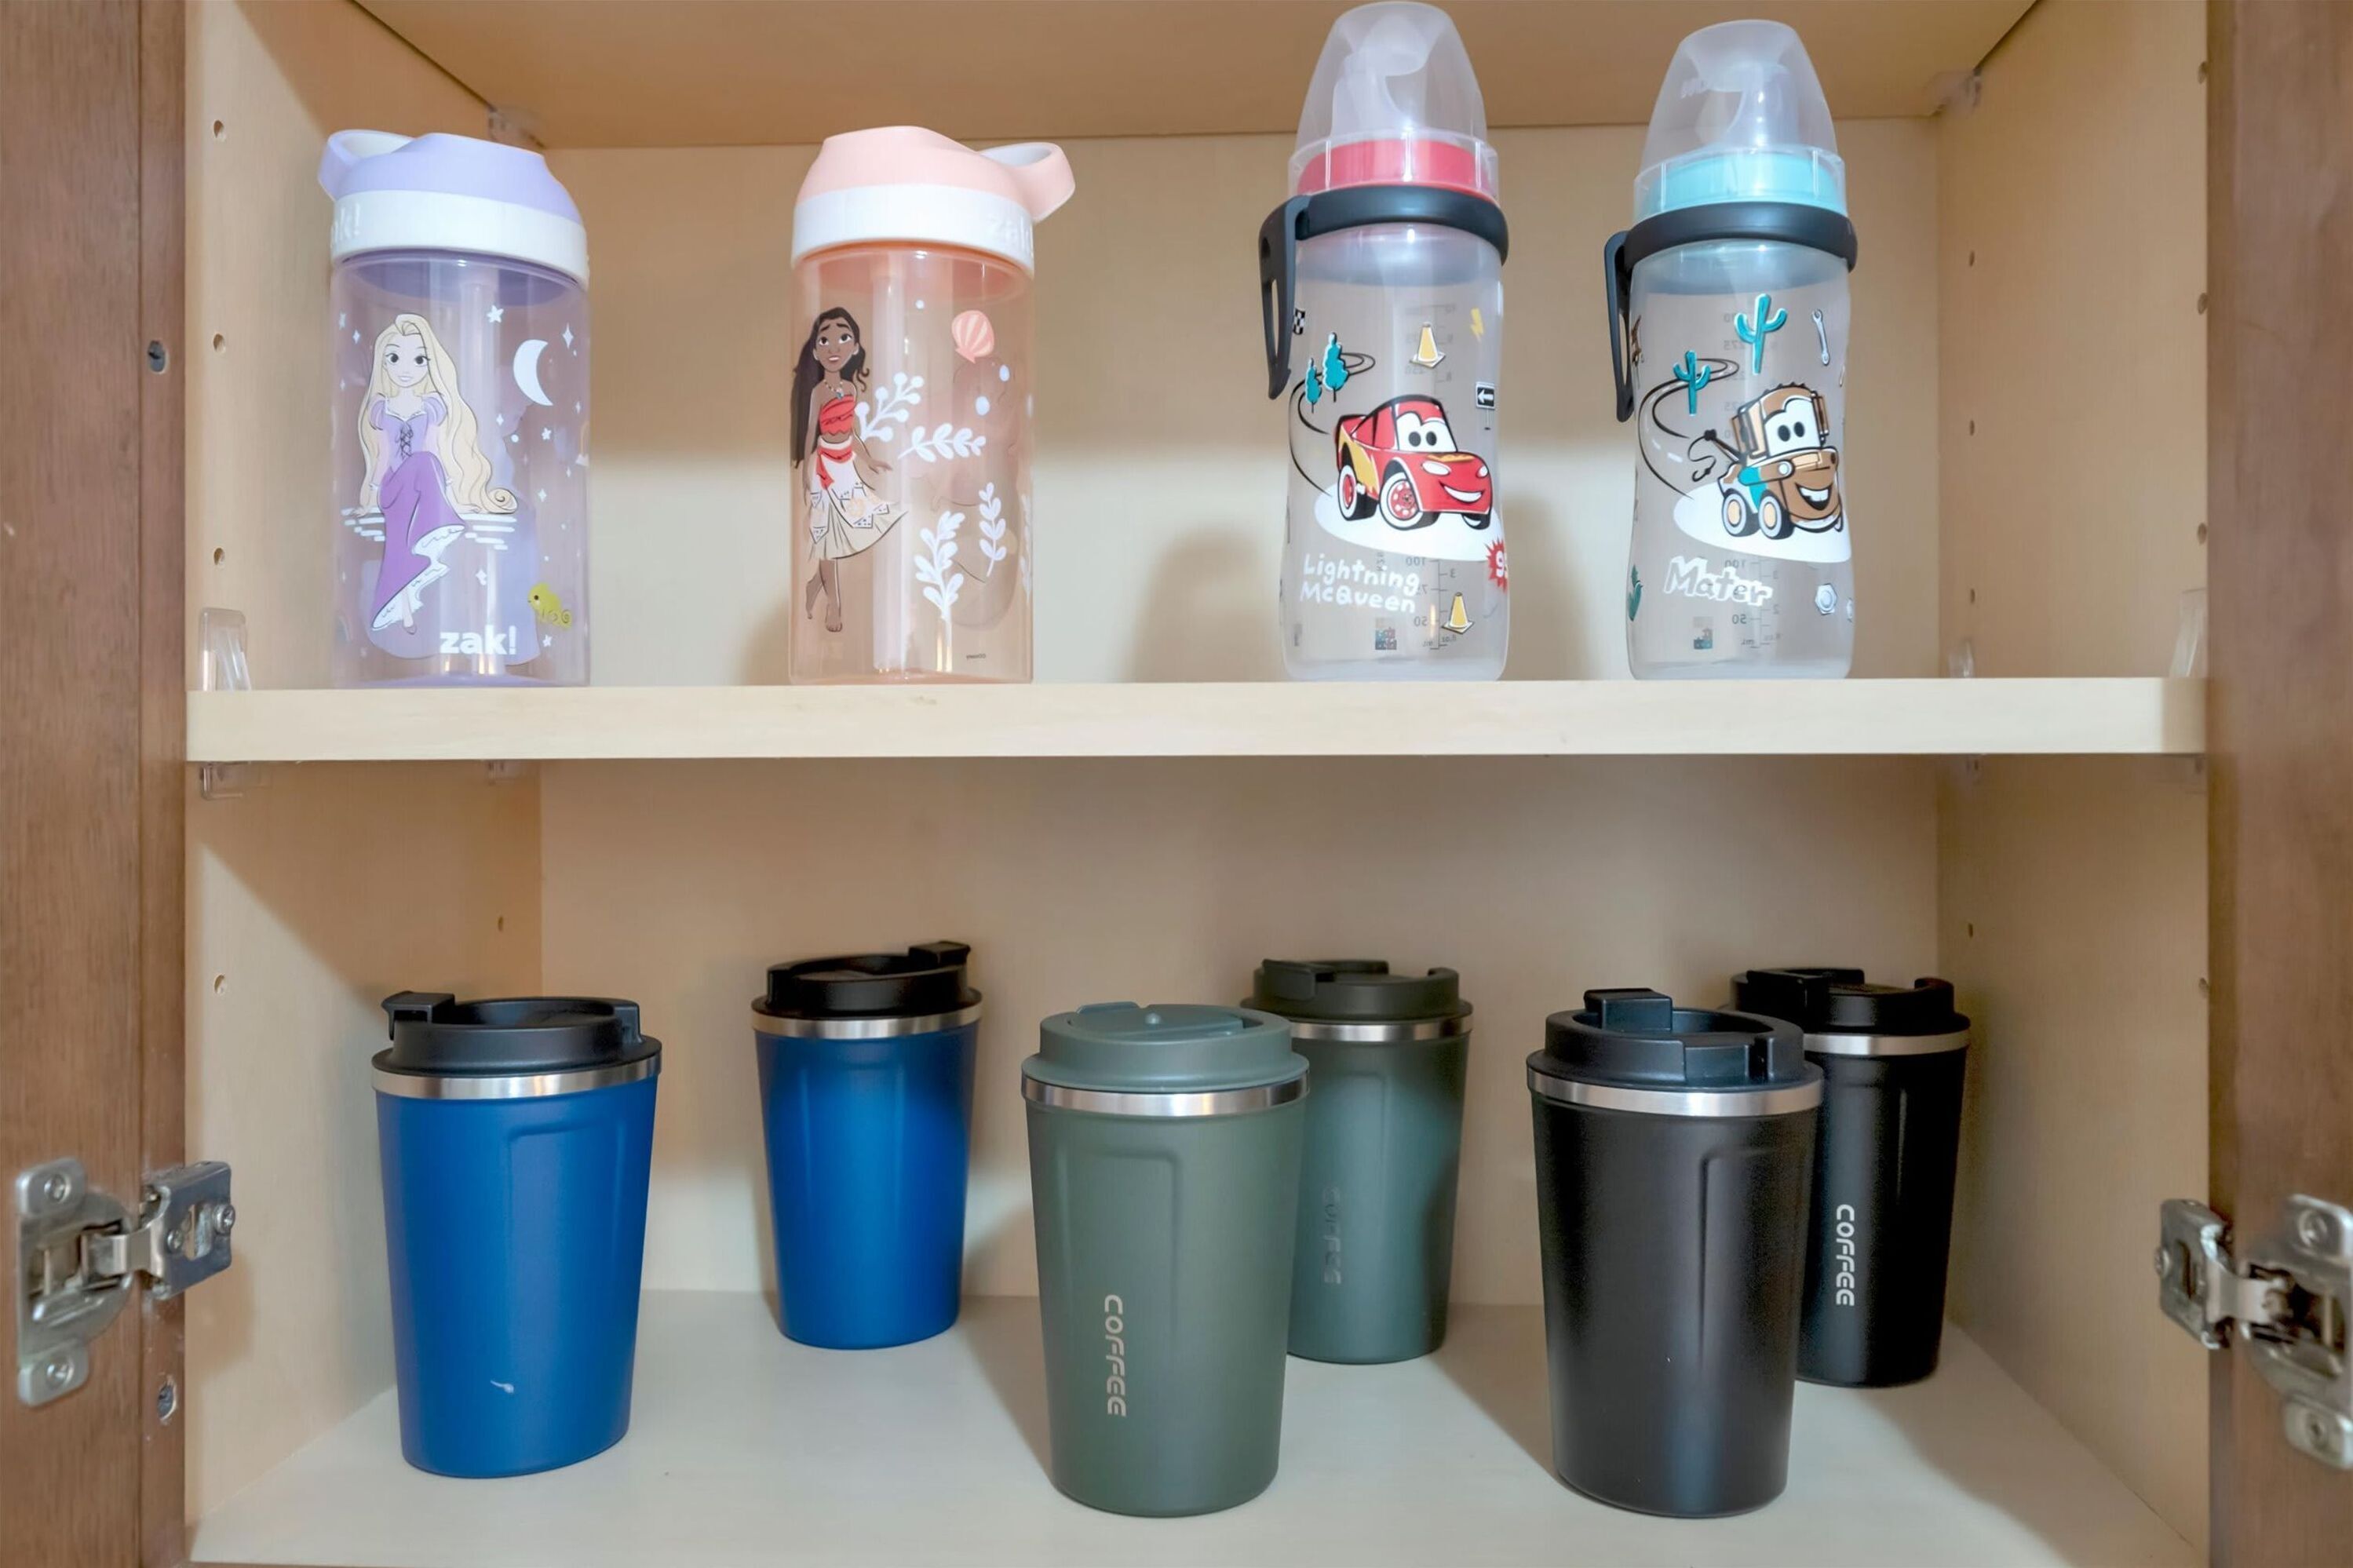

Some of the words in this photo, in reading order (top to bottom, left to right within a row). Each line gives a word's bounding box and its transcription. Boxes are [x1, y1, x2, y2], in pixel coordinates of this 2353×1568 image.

[1300, 581, 1416, 613] McQueen
[1303, 552, 1420, 596] Lightning
[1663, 556, 1773, 607] Mater
[440, 624, 517, 655] zak!
[1836, 1204, 1855, 1306] COFFEE
[1104, 1294, 1126, 1417] COFFEE
